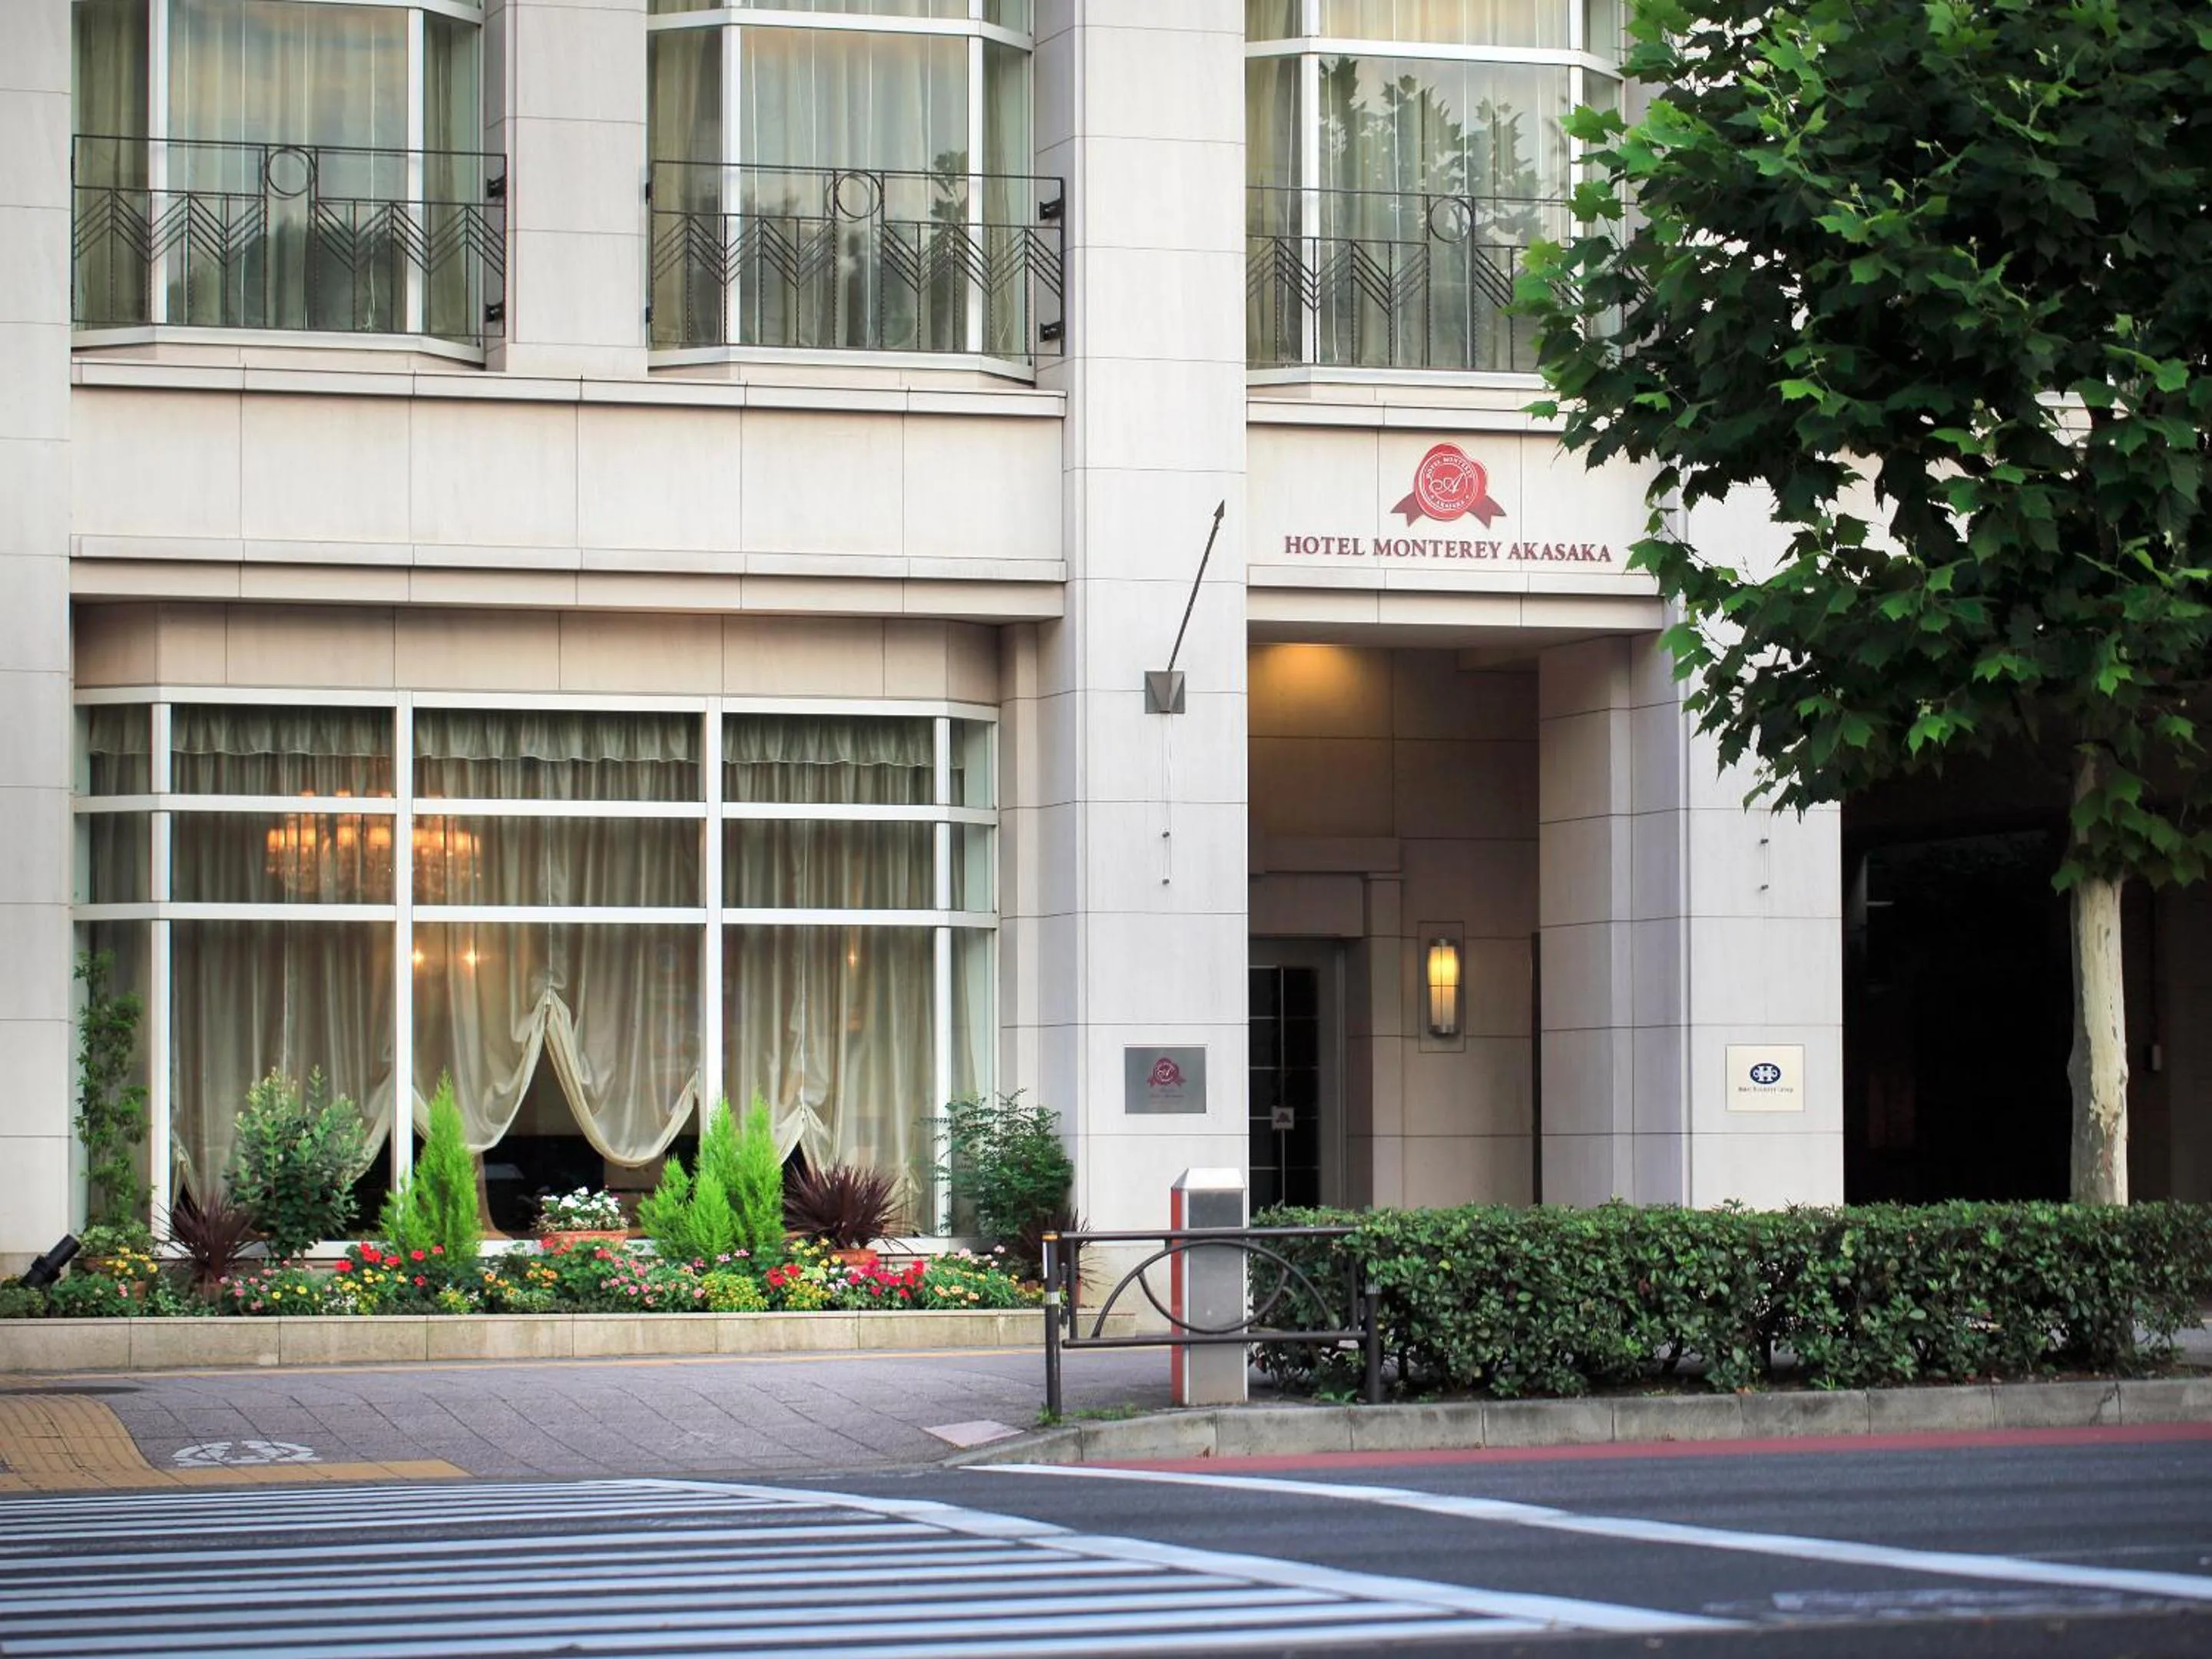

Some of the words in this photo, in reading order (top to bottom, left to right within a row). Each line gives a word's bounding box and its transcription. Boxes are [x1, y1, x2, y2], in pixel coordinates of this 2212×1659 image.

[1285, 535, 1365, 555] HOTEL
[1373, 538, 1502, 559] MONTEREY
[1508, 542, 1612, 562] AKASAKA
